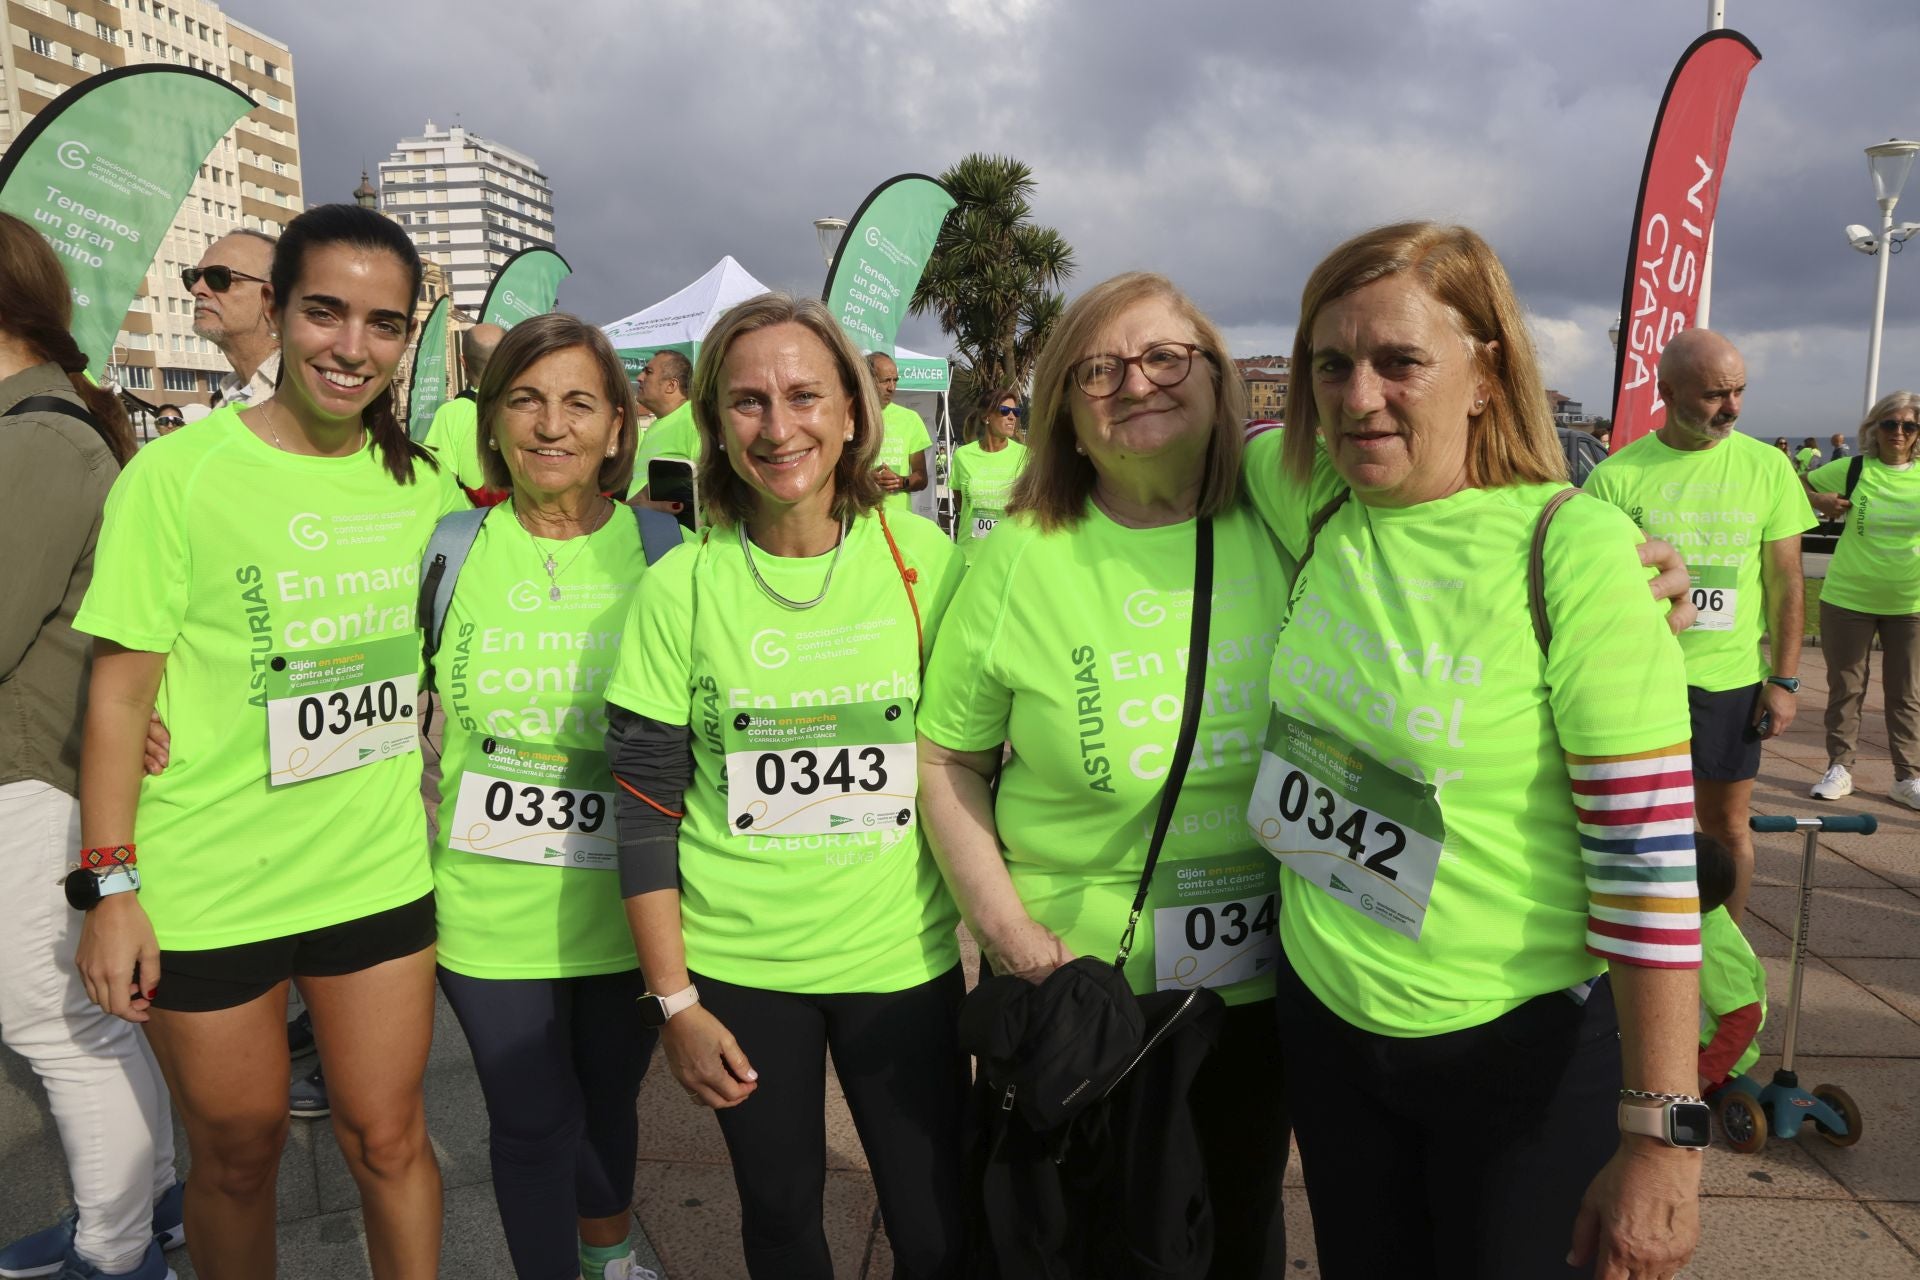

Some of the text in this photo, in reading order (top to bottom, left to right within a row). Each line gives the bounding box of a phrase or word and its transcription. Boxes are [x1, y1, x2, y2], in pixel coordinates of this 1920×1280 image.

[46, 186, 140, 242] Tenemos
[34, 208, 115, 251] un gran
[41, 232, 103, 268] amino
[854, 274, 868, 287] un
[859, 258, 901, 297] Tenemos
[850, 288, 890, 314] camino
[1624, 212, 1669, 390] CYASA
[1650, 154, 1714, 433] NISS
[494, 314, 513, 330] Tene
[844, 302, 866, 316] por
[842, 314, 884, 342] delante
[978, 519, 998, 530] 00
[1650, 510, 1674, 524] En
[1680, 507, 1757, 524] marcha
[1856, 495, 1868, 537] ASTURIAS
[1732, 528, 1752, 546] el
[1687, 553, 1748, 566] ncer
[276, 560, 419, 602] En marc
[1692, 588, 1724, 612] 06
[283, 603, 410, 648] contra
[796, 625, 852, 640] asociación
[480, 628, 621, 654] En mar
[797, 640, 832, 651] contra
[834, 637, 844, 646] el
[1296, 593, 1332, 634] En
[1334, 620, 1484, 687] marcha
[288, 652, 365, 672] Gijón en marcha
[798, 646, 858, 663] en Asturias
[1110, 633, 1276, 681] En marc
[289, 662, 365, 681] contra el cáncer
[450, 622, 478, 732] STURIAS
[790, 670, 918, 708] marcha
[1274, 646, 1466, 750] contra el
[298, 680, 398, 741] 0340
[487, 696, 609, 738] cánc
[748, 714, 837, 728] Gijón en marcha
[1072, 645, 1116, 794] ASTURIAS
[748, 724, 838, 736] contra el cáncer
[1288, 724, 1312, 742] Gijón
[488, 754, 568, 773] contra el cáncer
[495, 744, 569, 764] ijón en marcha
[1288, 736, 1362, 783] contra el cáncer
[516, 768, 538, 776] CONTRA
[755, 746, 888, 796] 0343
[484, 780, 606, 834] 0339
[1278, 770, 1406, 881] 0342
[1176, 869, 1206, 880] Gijón
[1208, 868, 1222, 876] en
[1178, 872, 1266, 890] contra el cáncer
[1184, 894, 1278, 950] 034
